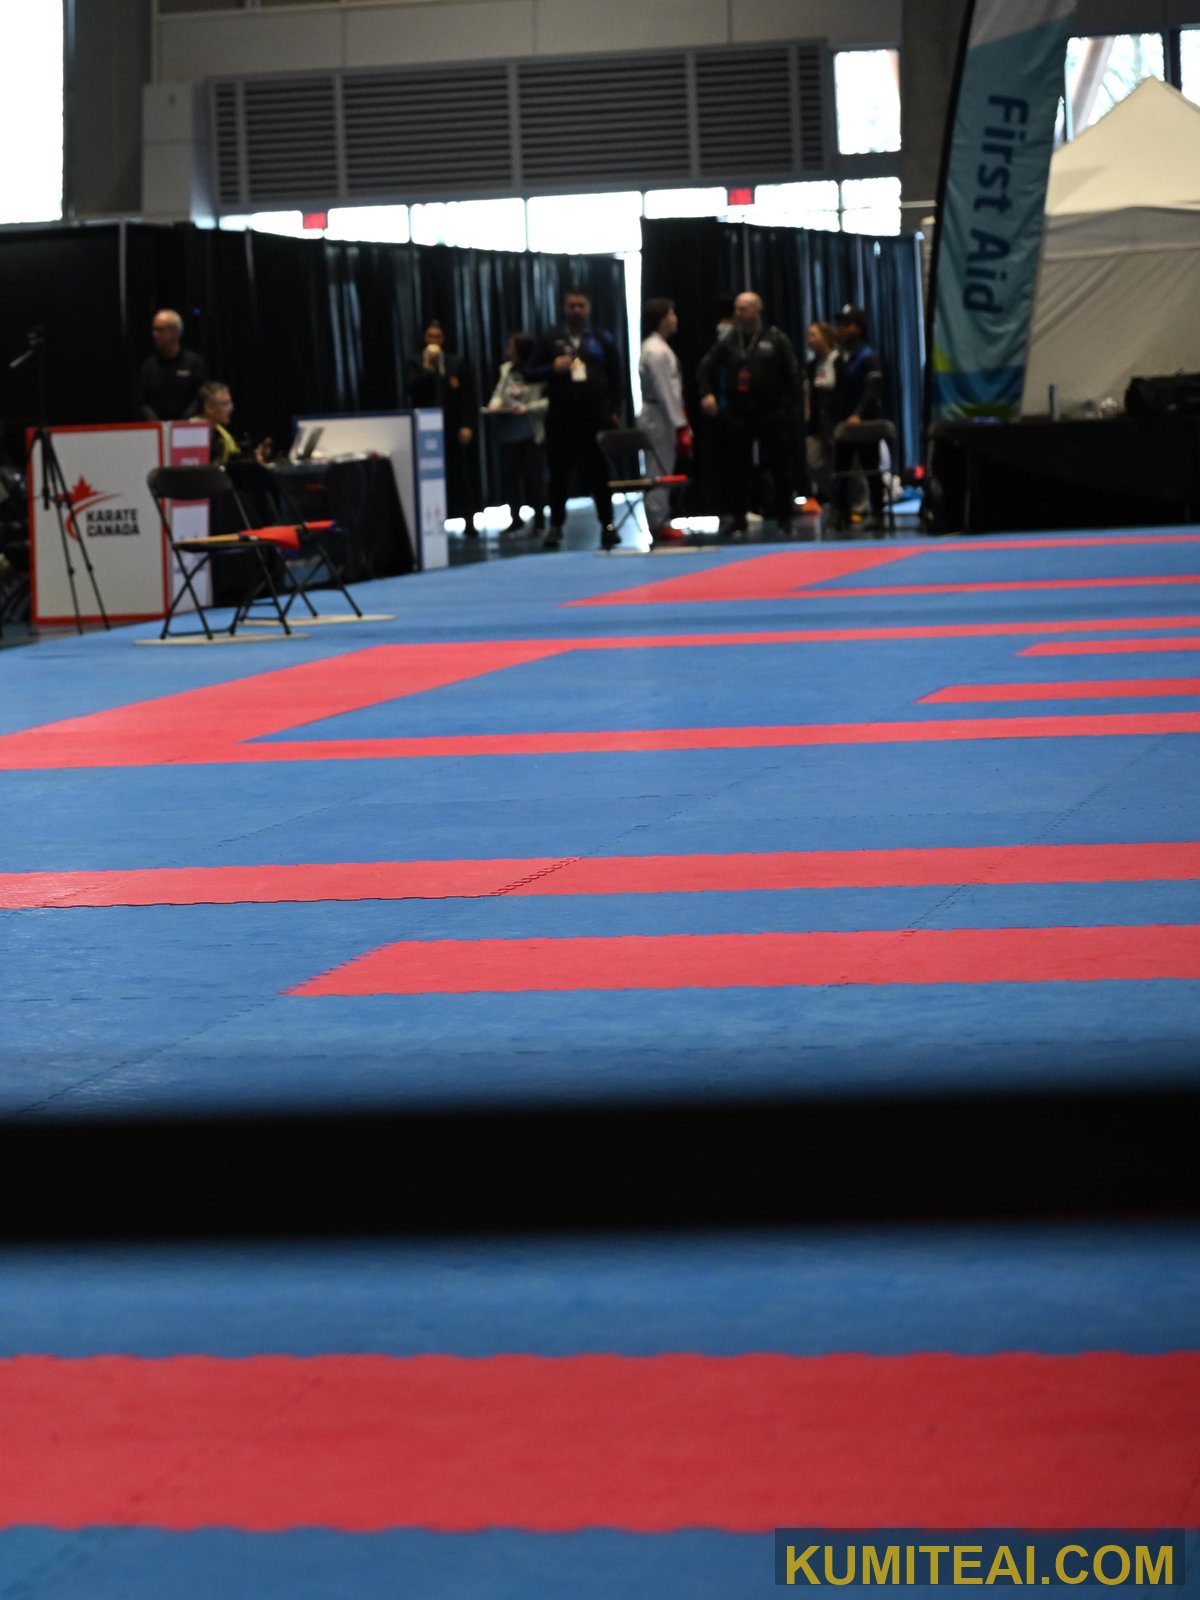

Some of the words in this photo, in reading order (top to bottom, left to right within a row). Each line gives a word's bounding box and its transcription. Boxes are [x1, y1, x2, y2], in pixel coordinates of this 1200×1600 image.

[973, 95, 1029, 213] First
[963, 229, 1012, 315] Aid
[86, 508, 138, 521] KARATE
[87, 522, 140, 537] CANADA
